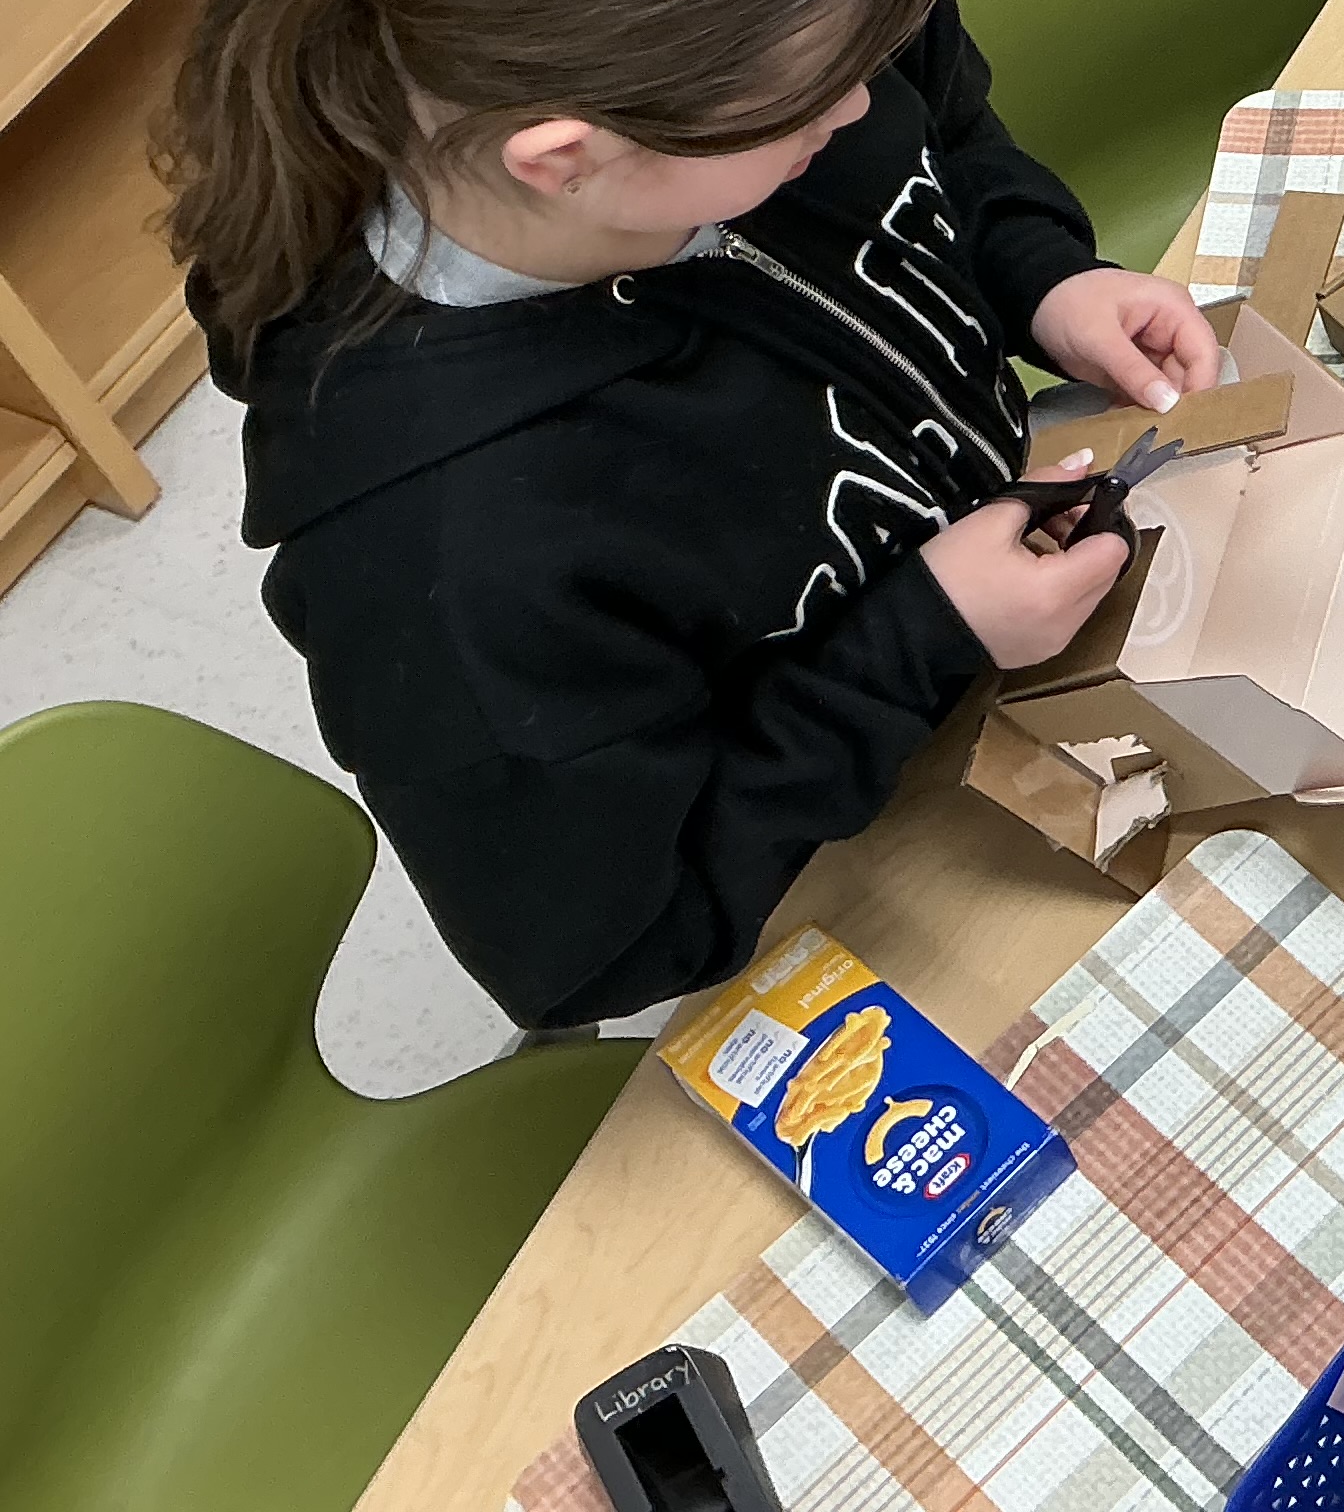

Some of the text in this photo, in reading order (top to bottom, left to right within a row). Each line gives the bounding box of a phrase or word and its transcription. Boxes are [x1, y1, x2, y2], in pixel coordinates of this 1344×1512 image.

[798, 959, 854, 1011] original
[740, 1027, 756, 1045] no
[759, 1037, 774, 1054] no
[777, 1047, 792, 1065] no
[891, 1123, 968, 1196] mac &
[931, 1160, 961, 1190] Kraft
[594, 1360, 691, 1424] Library
